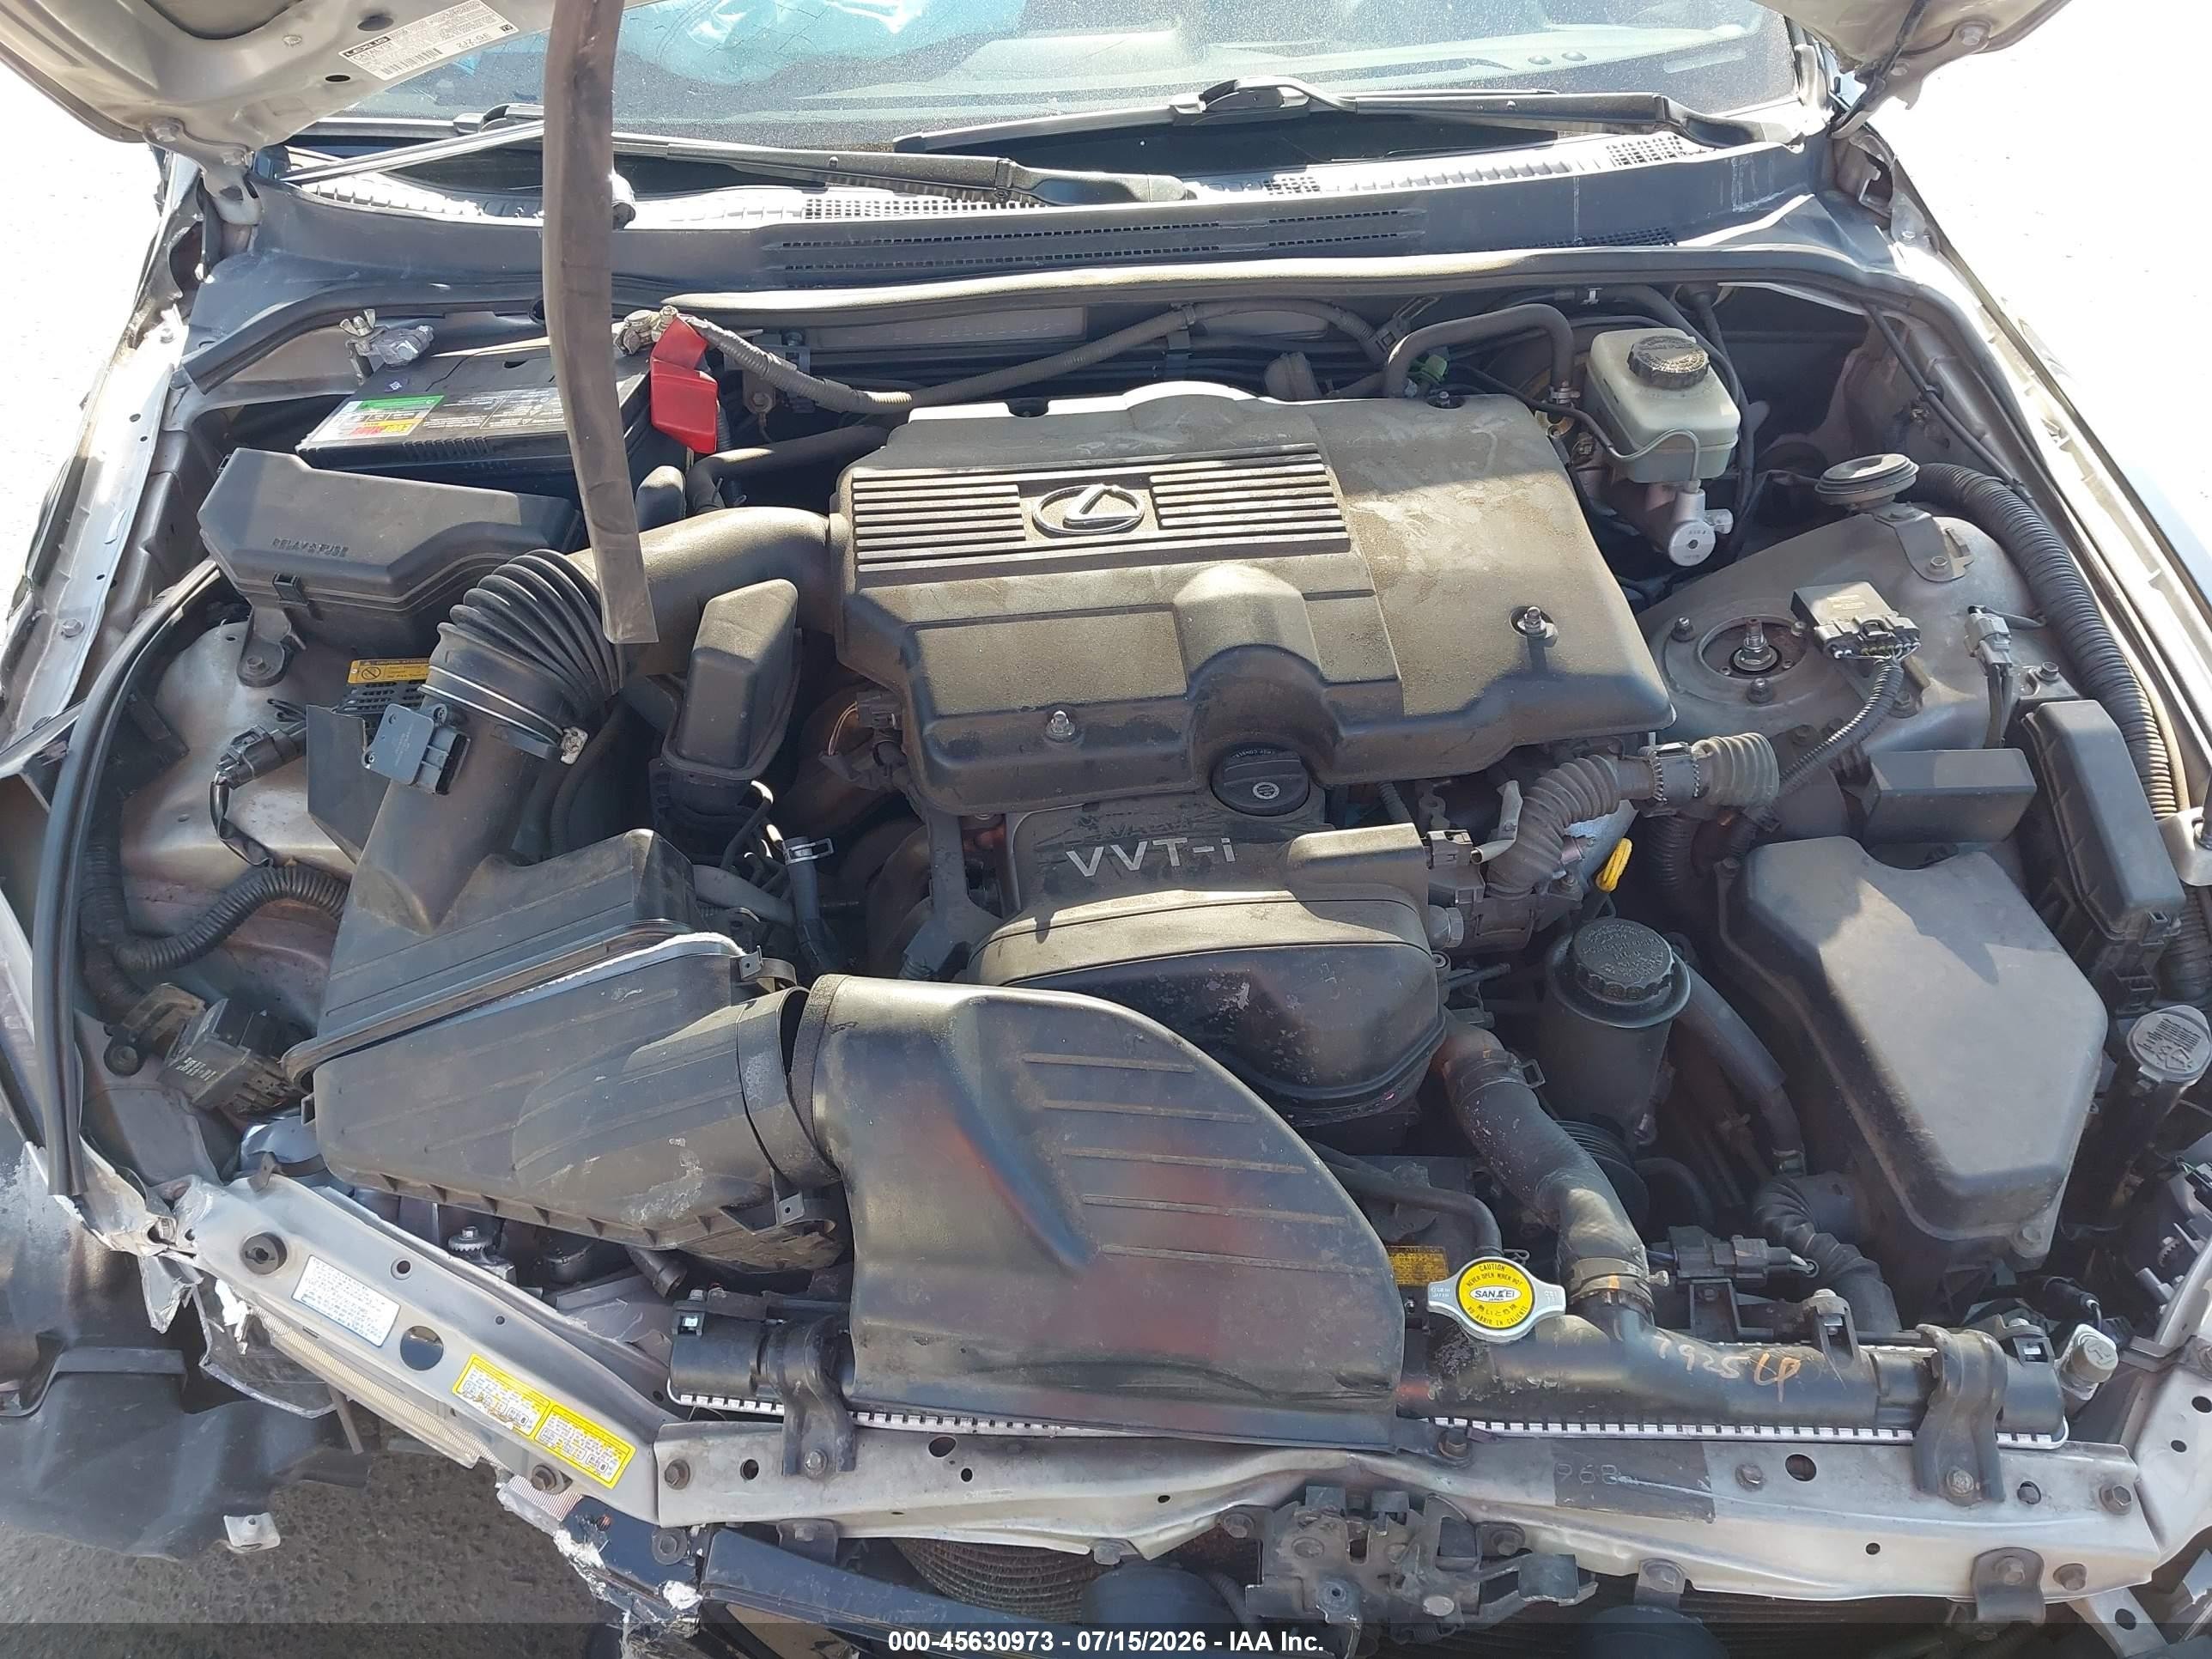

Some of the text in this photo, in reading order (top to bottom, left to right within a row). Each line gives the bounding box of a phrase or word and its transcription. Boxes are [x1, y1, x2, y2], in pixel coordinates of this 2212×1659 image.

[1066, 837, 1236, 878] VVT-i
[1479, 1263, 1506, 1273] CAUTION
[1466, 1275, 1480, 1287] NEVER
[1497, 1273, 1512, 1281] WHEN
[1476, 1315, 1492, 1325] ABRIR
